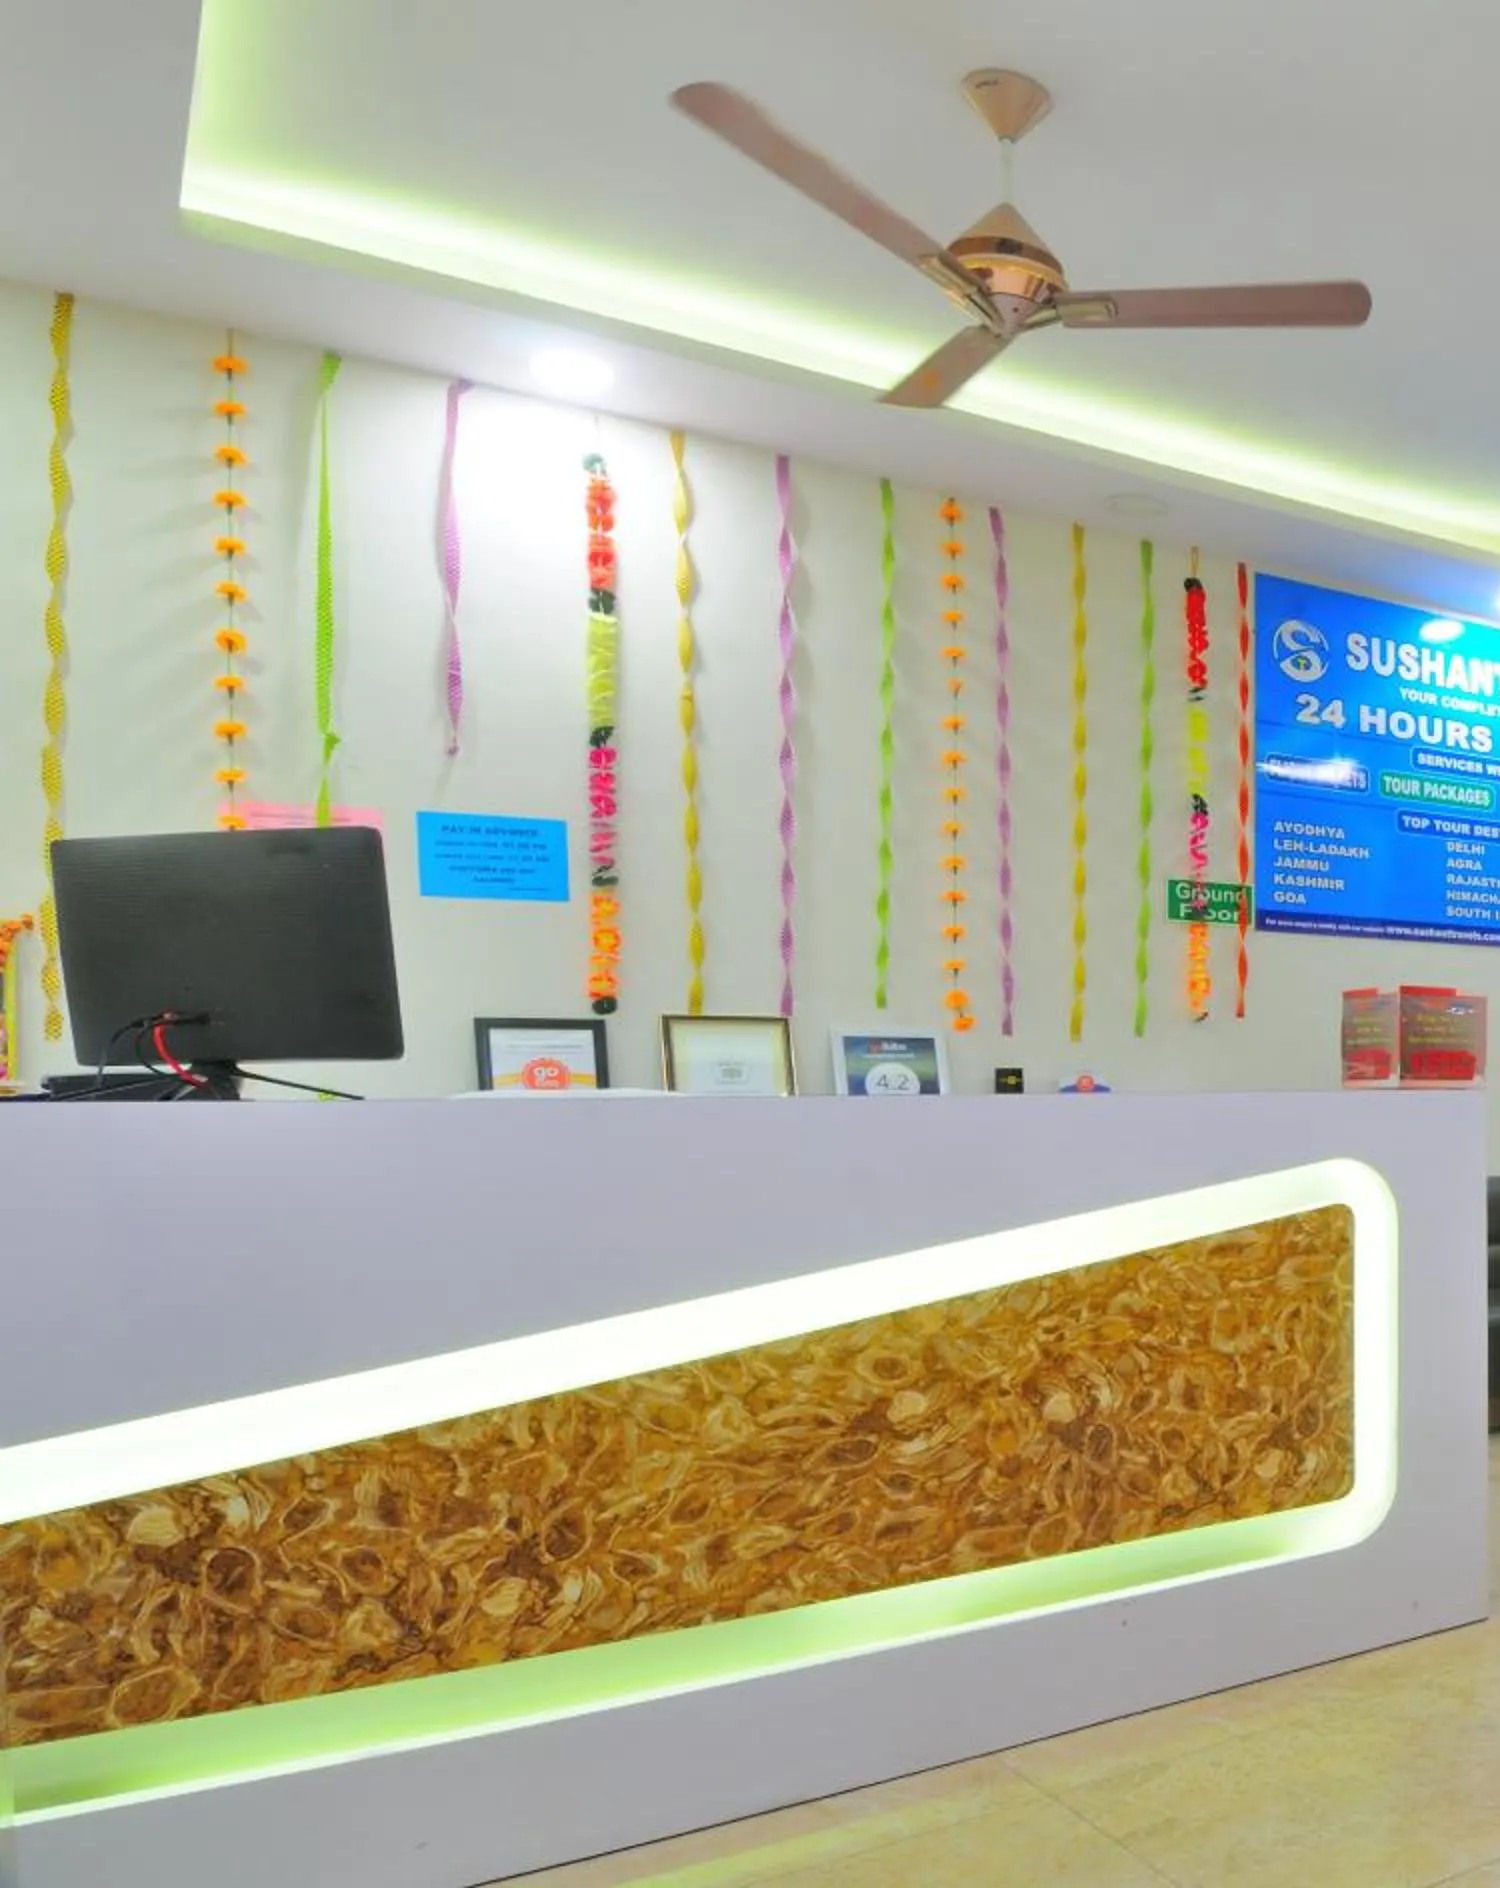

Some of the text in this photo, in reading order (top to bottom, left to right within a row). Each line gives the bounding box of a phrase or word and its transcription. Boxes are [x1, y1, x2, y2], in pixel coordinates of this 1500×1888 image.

[1400, 687, 1438, 704] YOUR
[1296, 694, 1346, 728] 24
[1359, 704, 1493, 752] HOURS
[1417, 753, 1483, 773] SERVICES
[1383, 776, 1490, 806] TOUR PACKAGES
[1273, 821, 1345, 839] AYODHYA
[1402, 815, 1431, 829] TOP
[1433, 819, 1471, 833] TOUR
[1273, 839, 1369, 858] LEH-LADAKH
[1447, 841, 1485, 856] DELHI
[1273, 856, 1329, 871] JAMMU
[1447, 858, 1483, 870] AGRA
[1273, 873, 1345, 890] KASHMIR
[1273, 891, 1307, 904] GOA
[1180, 903, 1240, 922] Foor
[1446, 906, 1491, 920] SOUTH
[875, 1073, 910, 1091] 4.2
